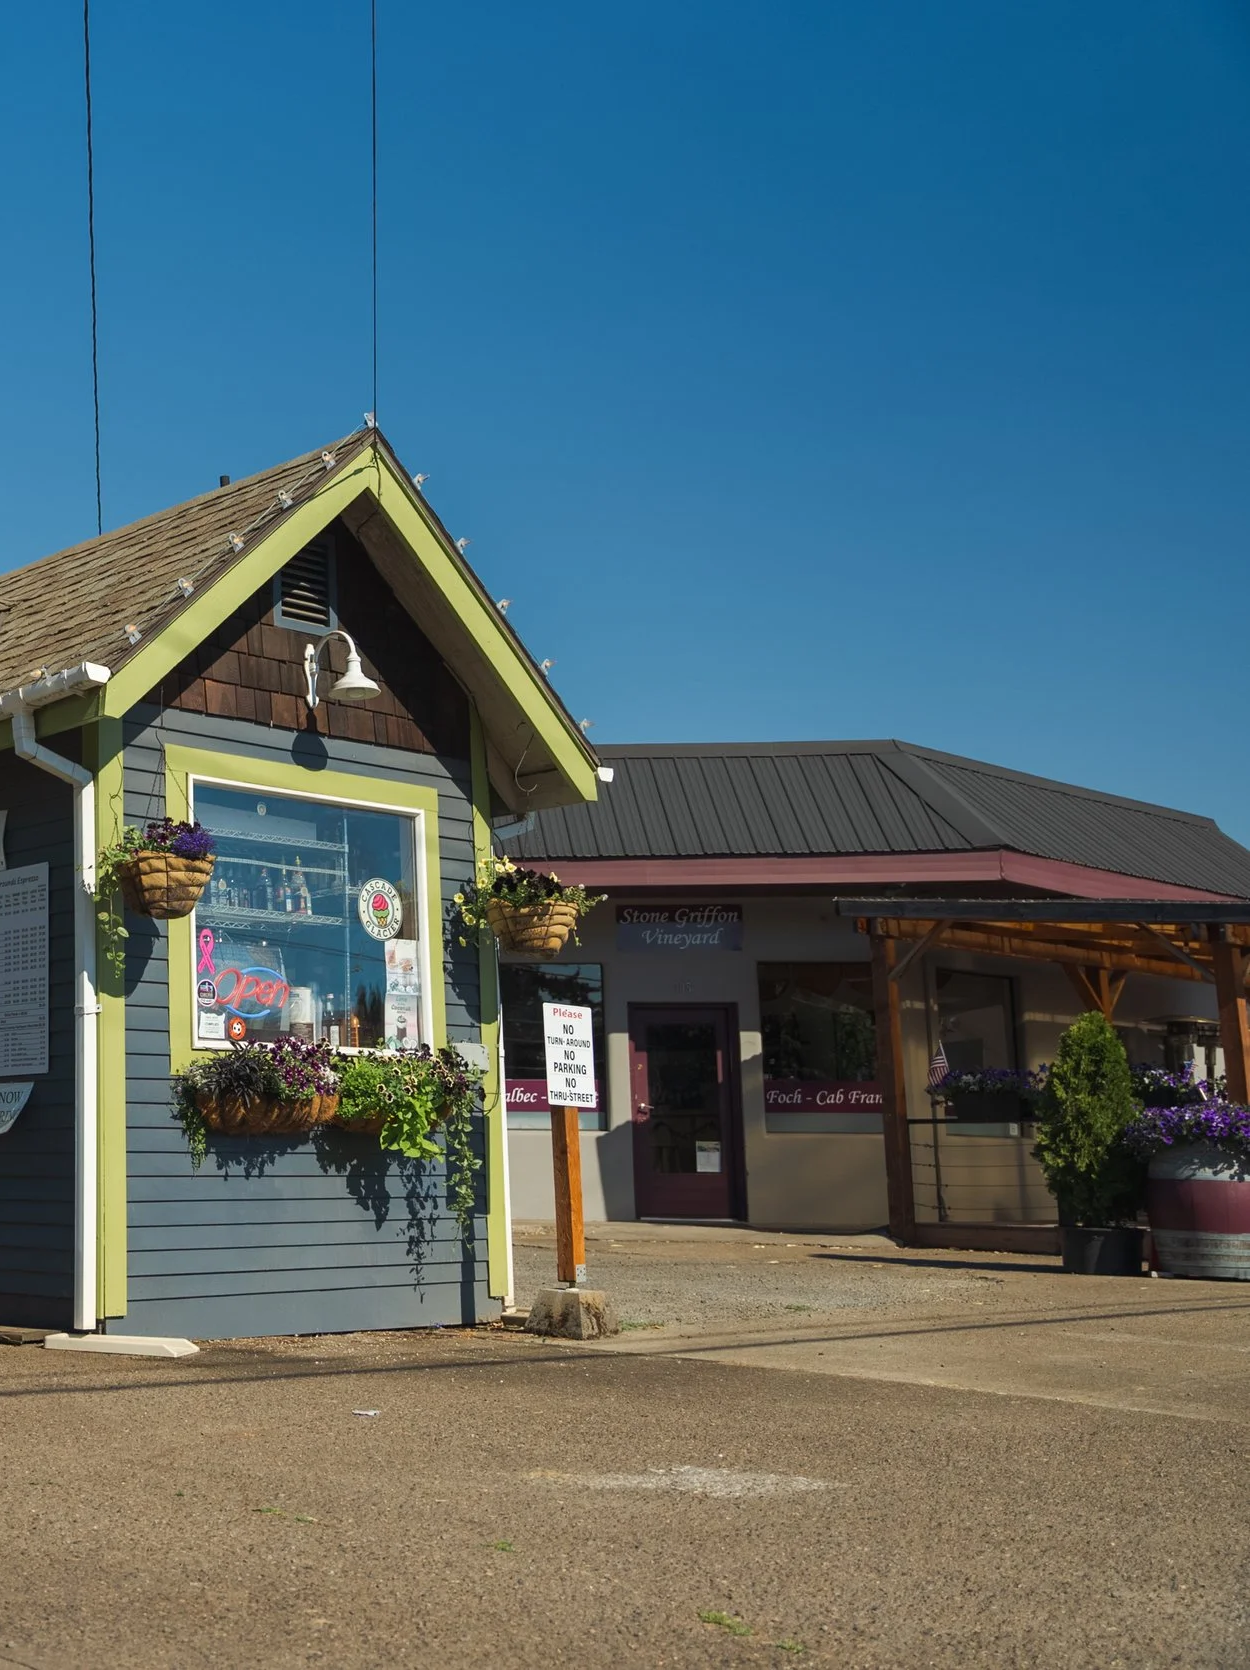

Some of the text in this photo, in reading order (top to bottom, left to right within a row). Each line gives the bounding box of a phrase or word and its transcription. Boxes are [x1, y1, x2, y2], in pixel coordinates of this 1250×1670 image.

[16, 876, 38, 886] Espresso
[362, 882, 398, 902] CASCADE
[620, 906, 738, 928] Stone Griffon
[366, 918, 400, 937] GLACIER
[641, 928, 724, 950] Vineyard
[214, 968, 290, 1009] Open
[552, 1008, 582, 1020] Please
[562, 1024, 574, 1035] NO
[566, 1038, 591, 1048] AROUND
[564, 1050, 575, 1060] NO
[554, 1062, 586, 1075] PARKING
[565, 1078, 576, 1088] NO
[506, 1088, 537, 1102] albec
[550, 1090, 594, 1103] THRU-STREET
[766, 1088, 802, 1104] Foch
[816, 1089, 844, 1105] Cab
[848, 1090, 883, 1104] Fran
